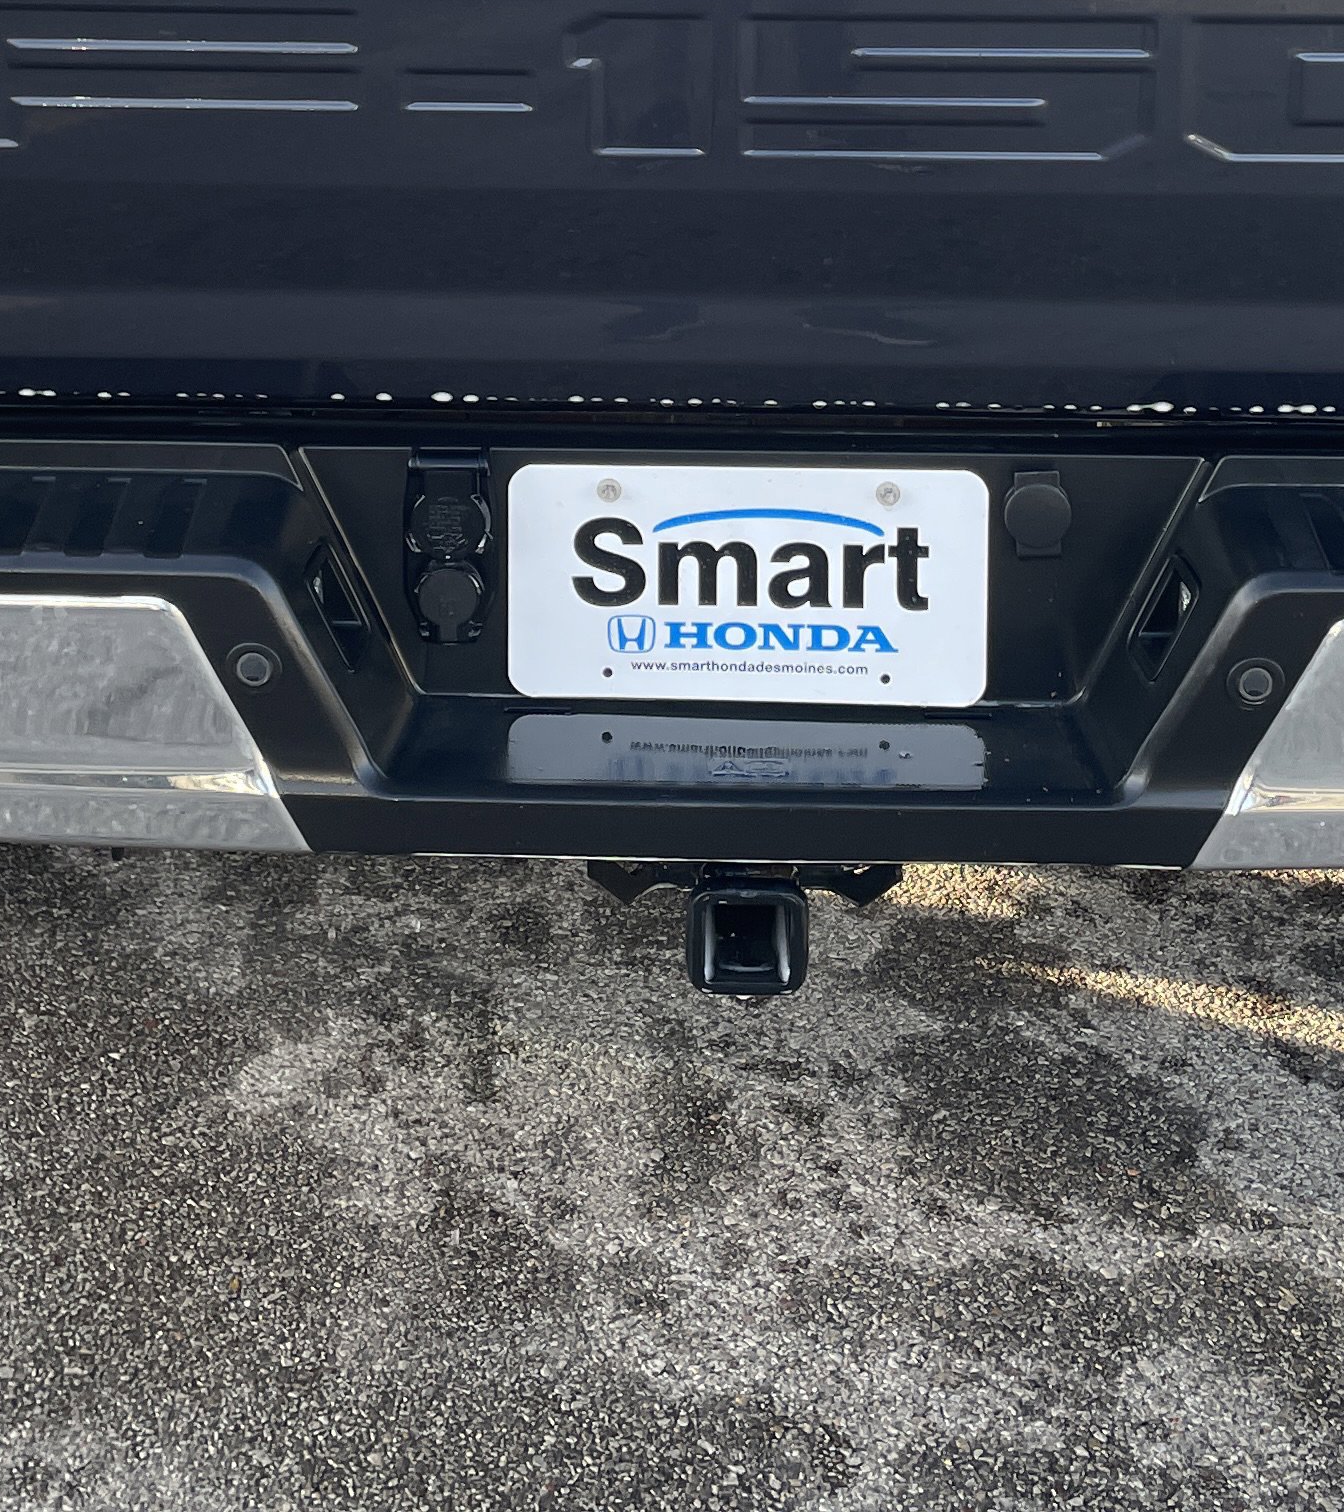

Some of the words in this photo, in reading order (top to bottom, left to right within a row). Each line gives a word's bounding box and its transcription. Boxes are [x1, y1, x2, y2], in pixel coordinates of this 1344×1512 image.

[571, 516, 930, 611] Smart
[663, 621, 899, 654] HONDA
[630, 659, 869, 676] www.smarthondadesmoines.com
